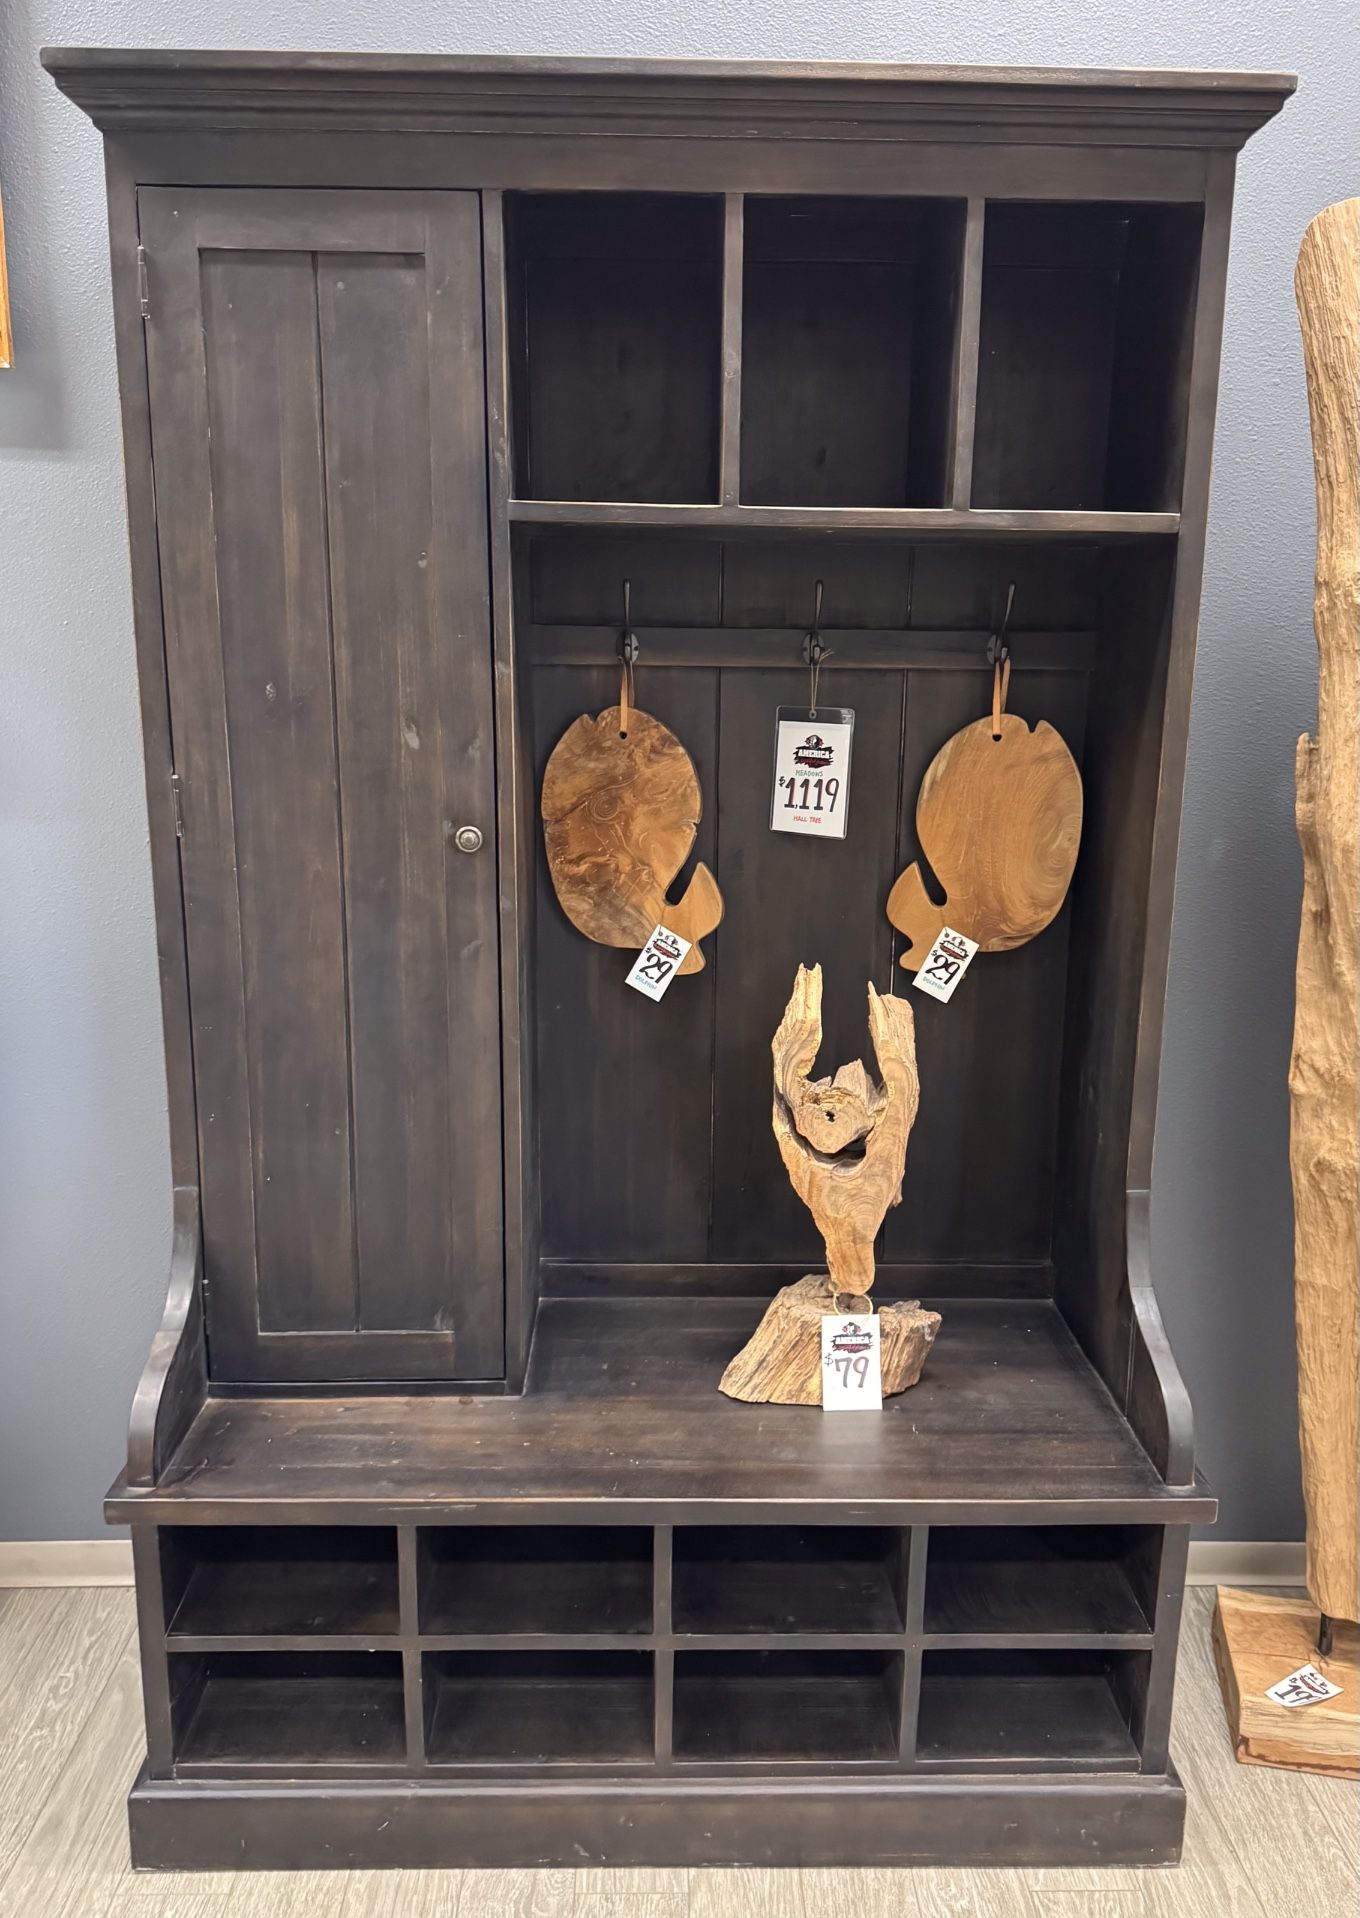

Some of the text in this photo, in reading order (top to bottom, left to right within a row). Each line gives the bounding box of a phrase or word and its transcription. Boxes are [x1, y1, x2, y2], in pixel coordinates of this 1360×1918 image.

[798, 748, 830, 759] AMERICA
[809, 816, 822, 824] TREE
[824, 1352, 870, 1389] $79
